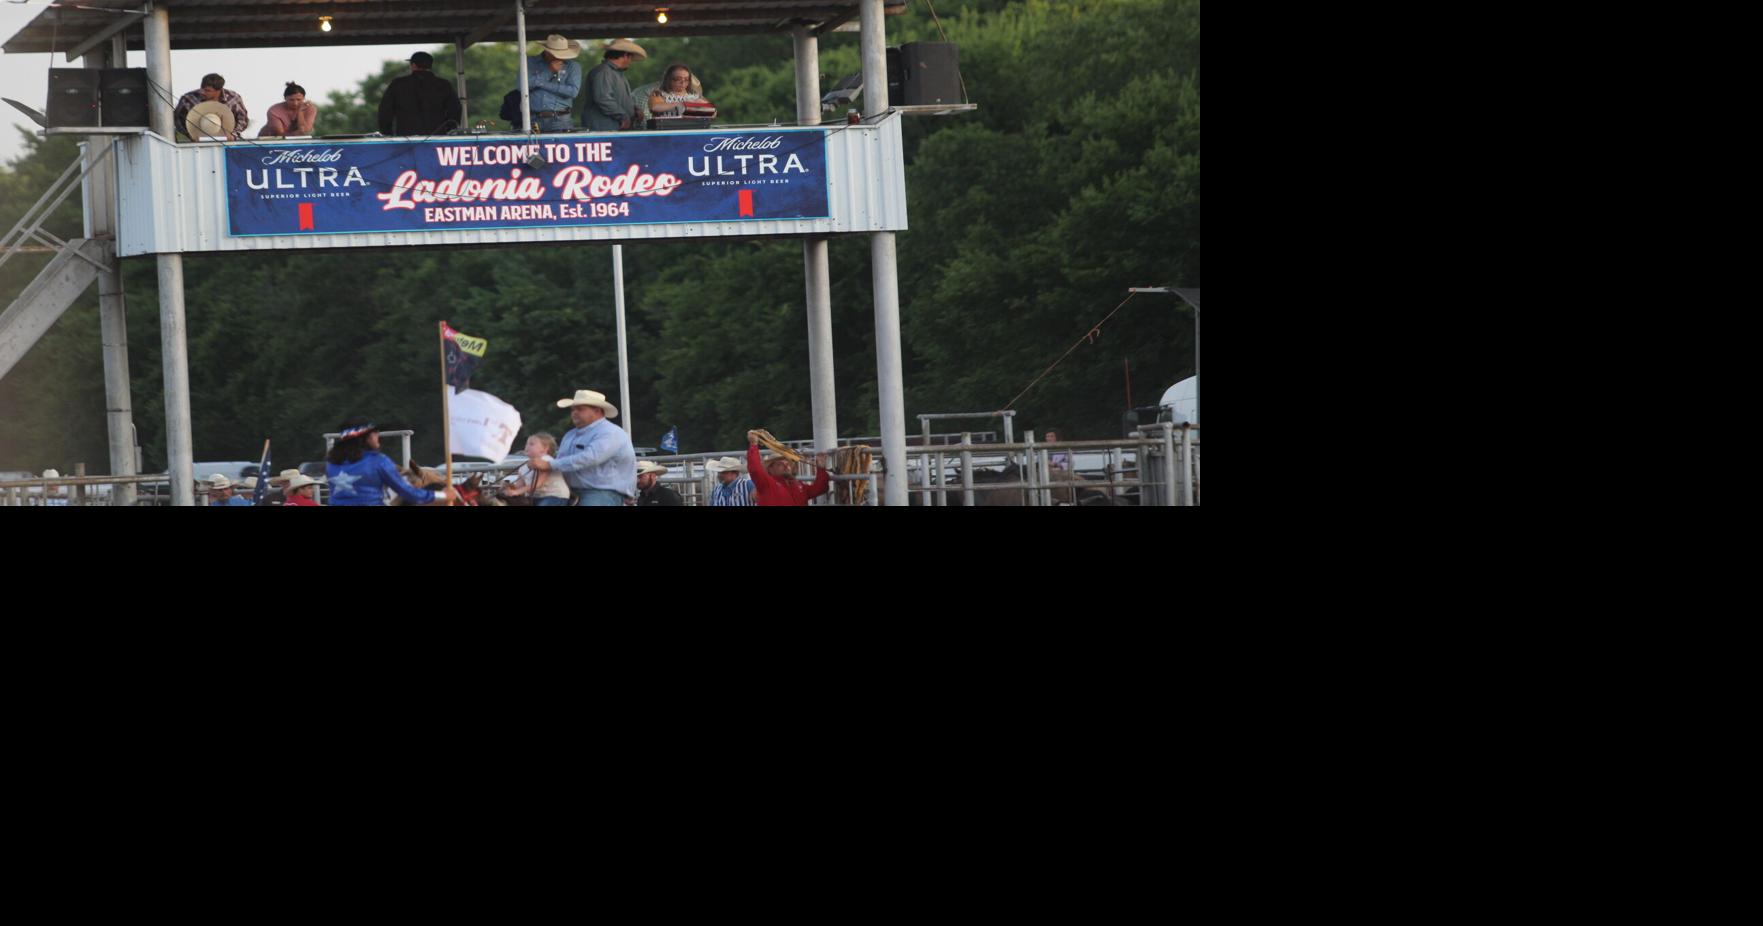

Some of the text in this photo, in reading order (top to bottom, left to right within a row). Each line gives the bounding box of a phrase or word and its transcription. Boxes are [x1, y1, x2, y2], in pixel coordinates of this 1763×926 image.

[545, 144, 570, 163] TO
[575, 142, 613, 162] THE
[703, 136, 784, 153] Michelob
[261, 148, 344, 166] Michelob
[688, 153, 806, 176] ULTRA
[246, 166, 367, 190] ULTRA
[377, 164, 682, 211] Ladonia Rodeo
[424, 202, 630, 223] EASTMAN ARENA, Est. 1964
